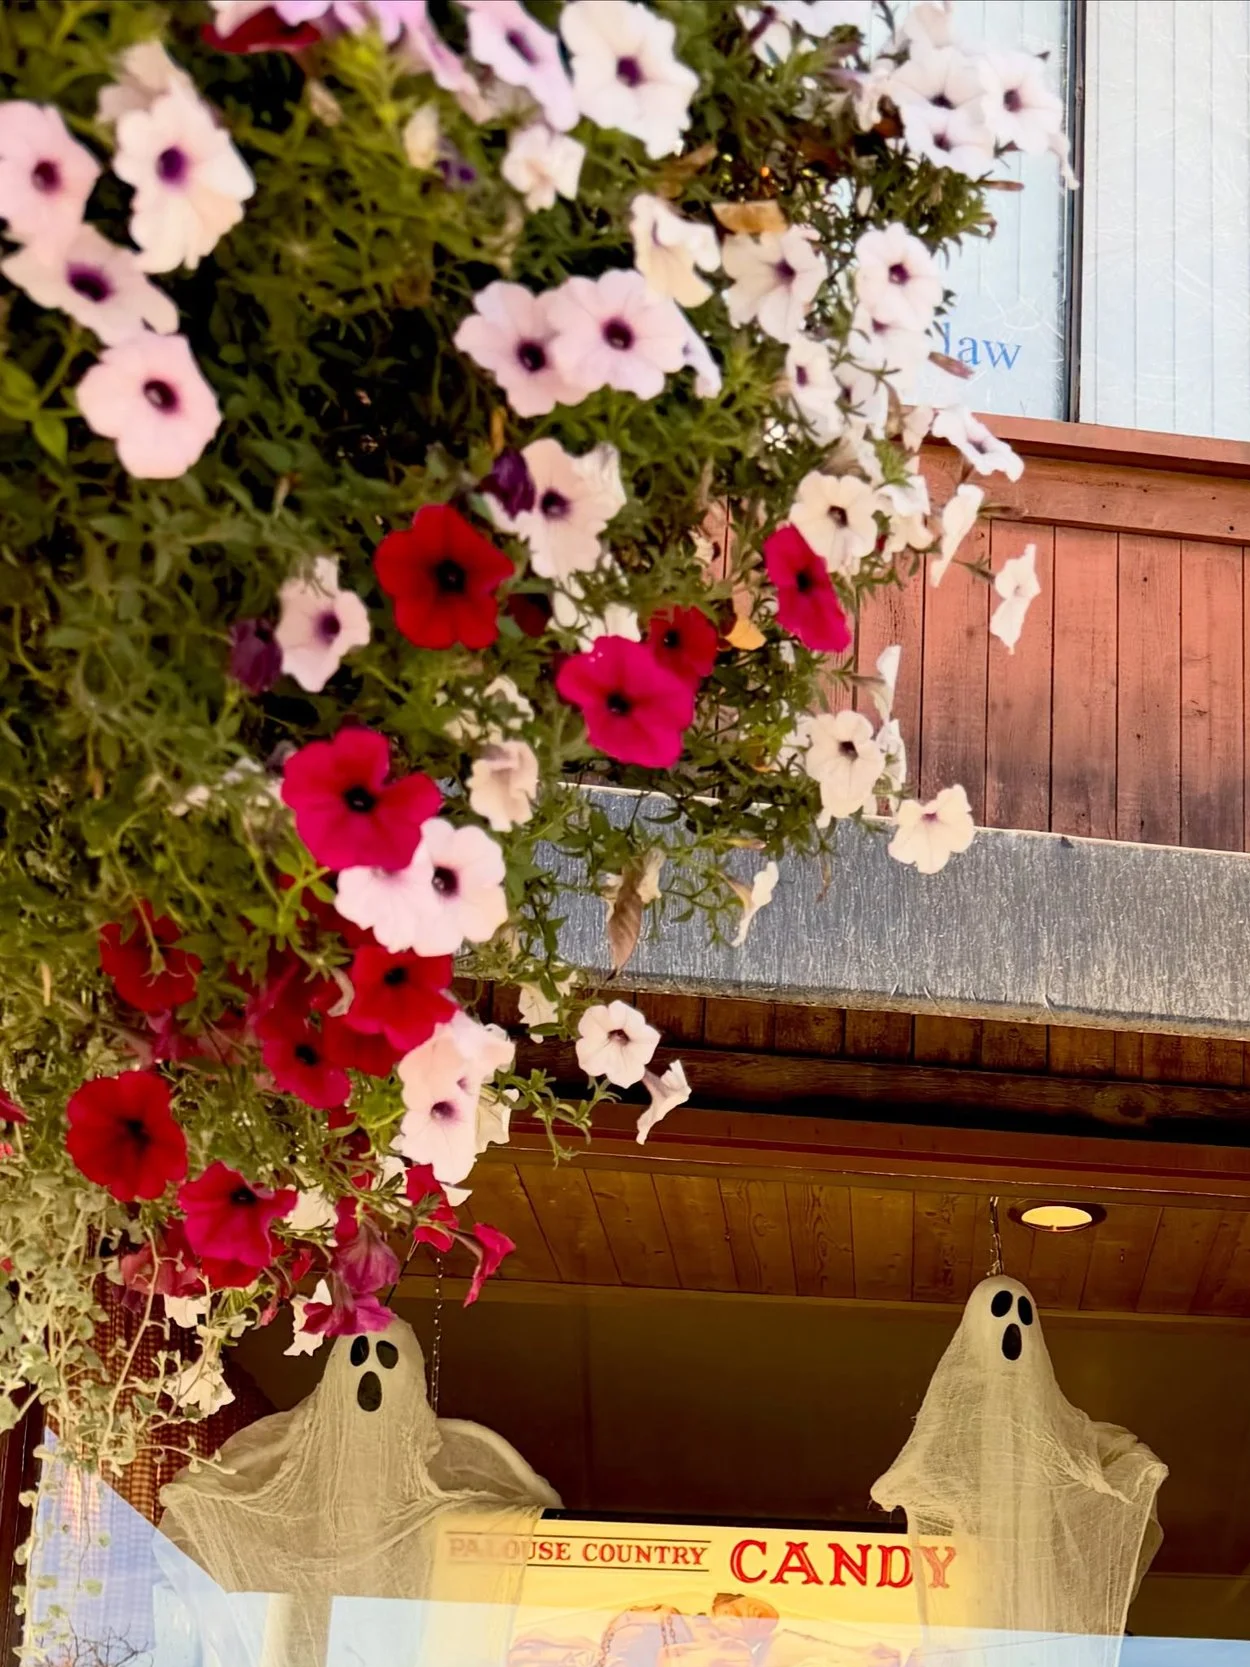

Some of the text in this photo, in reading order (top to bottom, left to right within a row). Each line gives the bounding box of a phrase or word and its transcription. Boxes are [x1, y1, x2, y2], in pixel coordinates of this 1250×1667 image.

[943, 322, 1022, 370] law
[582, 1542, 708, 1565] COUNTRY
[730, 1539, 957, 1588] CANDY
